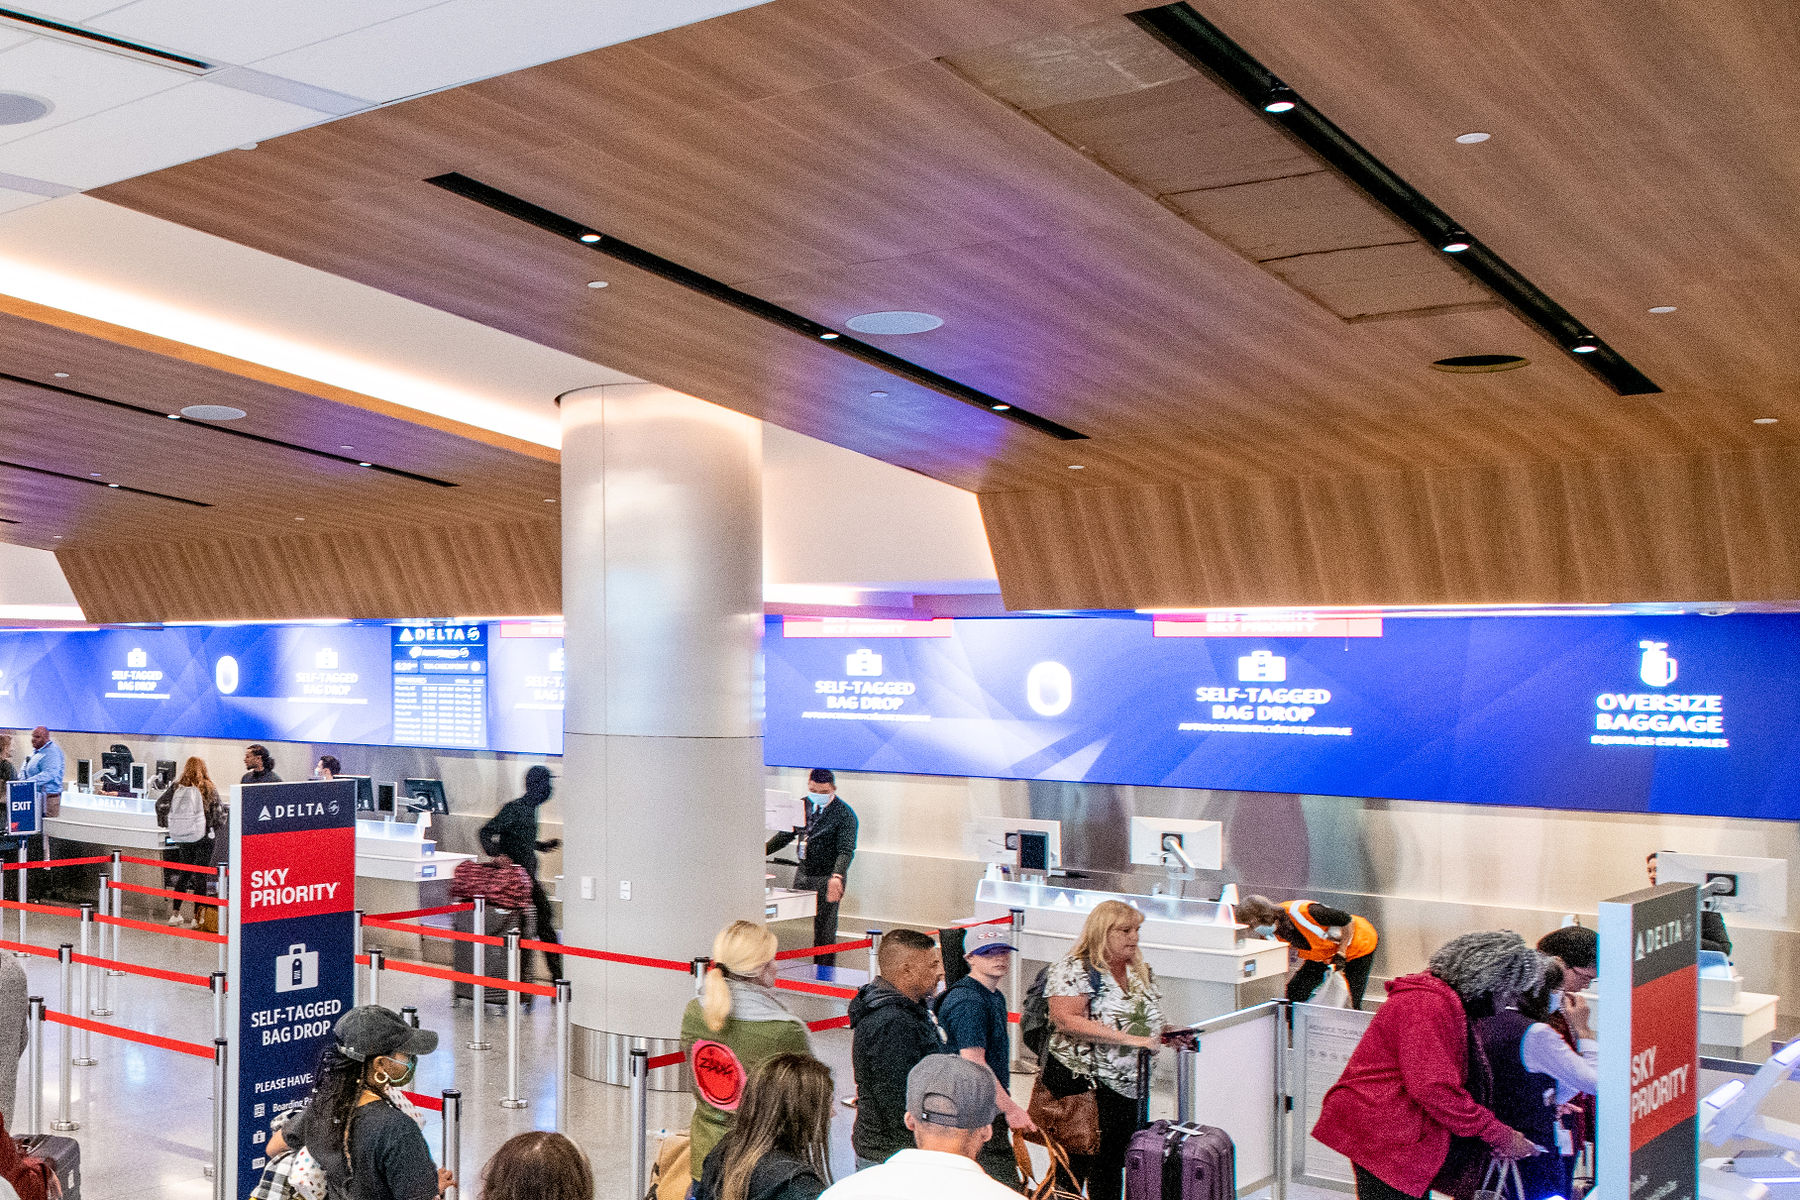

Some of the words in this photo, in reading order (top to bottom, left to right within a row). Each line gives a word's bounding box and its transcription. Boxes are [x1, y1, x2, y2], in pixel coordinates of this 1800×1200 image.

[415, 628, 465, 640] DELTA
[111, 670, 163, 681] SELF-TAGGED
[296, 673, 358, 684] SELF-TAGGED
[118, 681, 134, 691] BAG
[135, 682, 157, 691] DROP
[303, 684, 324, 695] BAG
[326, 685, 351, 696] DROP
[815, 681, 915, 696] SELF-TAGGED
[827, 696, 859, 710] BAG
[861, 697, 904, 710] DROP
[1196, 687, 1332, 704] SELF-TAGGED
[1596, 693, 1723, 712] OVERSIZE
[1212, 705, 1254, 720] BAG
[1257, 706, 1315, 722] DROP
[1596, 713, 1724, 733] BAGGAGE
[12, 801, 31, 811] EXIT
[100, 799, 126, 809] DELTA
[275, 803, 324, 818] DELTA
[251, 868, 289, 888] SKY
[251, 882, 338, 908] PRIORITY
[1646, 919, 1682, 954] DELTA
[251, 1000, 341, 1028] SELF-TAGGED
[262, 1027, 290, 1046] BAG
[294, 1020, 331, 1041] DROP
[1631, 1046, 1656, 1087] SKY
[255, 1079, 286, 1094] PLEASE
[287, 1073, 314, 1087] HAVE:
[1631, 1064, 1689, 1124] PRIORITY
